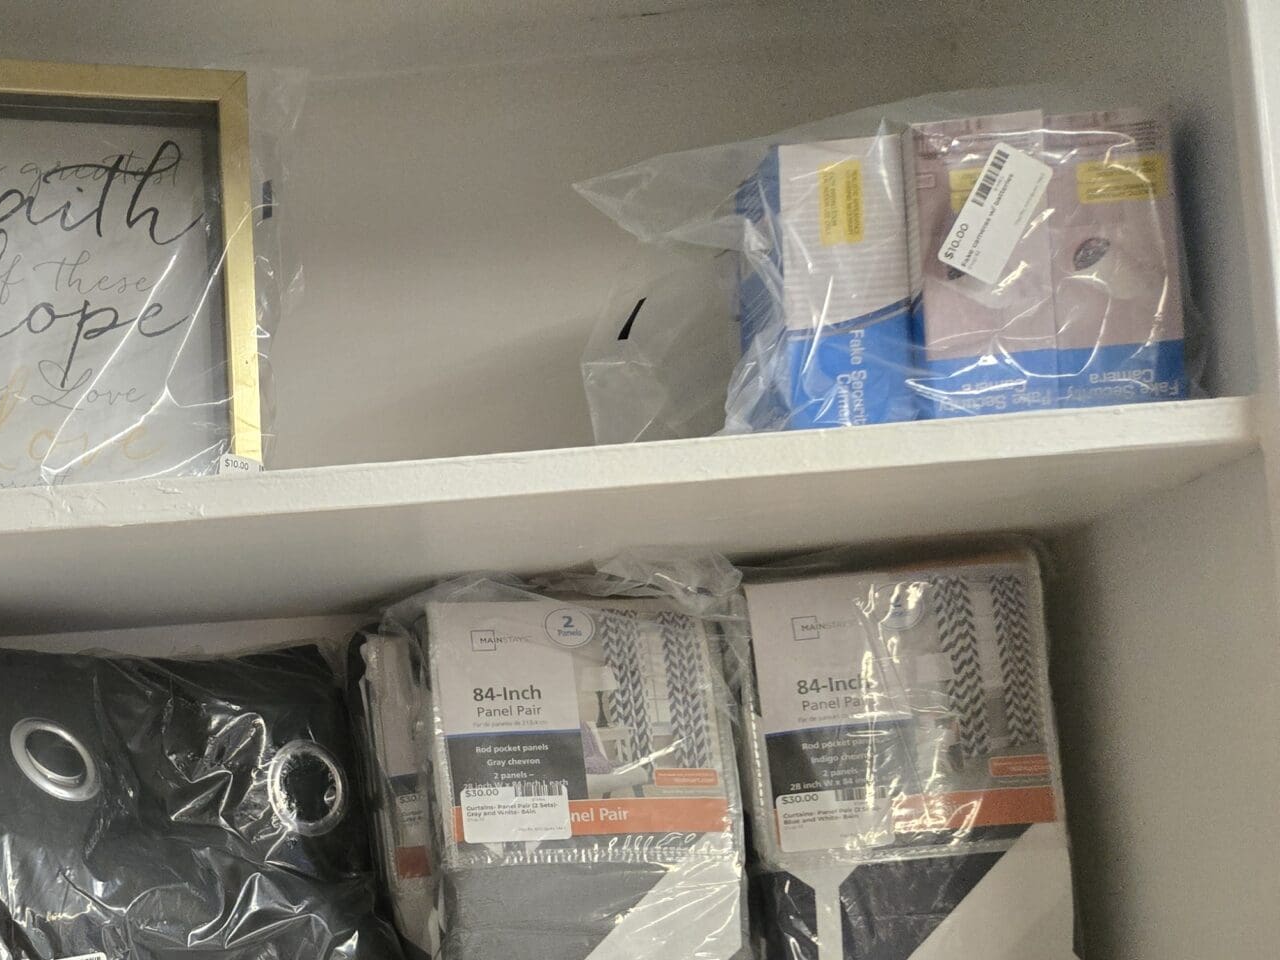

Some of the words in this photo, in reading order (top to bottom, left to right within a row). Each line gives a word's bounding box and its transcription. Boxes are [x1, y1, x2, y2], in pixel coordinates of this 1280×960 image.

[945, 223, 969, 260] $10.00
[33, 256, 155, 294] these
[849, 329, 864, 365] Fake
[836, 374, 851, 425] Camer
[224, 459, 249, 471] $10.00
[562, 616, 574, 628] 2
[473, 684, 542, 702] 84-Inch
[802, 697, 840, 711] Panel
[477, 705, 512, 718] Panel
[517, 704, 542, 716] Pair
[494, 744, 520, 754] pocket
[522, 743, 549, 752] panels
[802, 742, 819, 750] Rod
[486, 759, 506, 767] Gray
[508, 757, 540, 766] chevron
[501, 771, 527, 780] panels
[465, 788, 499, 798] $30.00
[790, 783, 801, 791] 28
[781, 794, 818, 804] $30.00
[571, 808, 595, 823] nel
[599, 807, 629, 822] Pair
